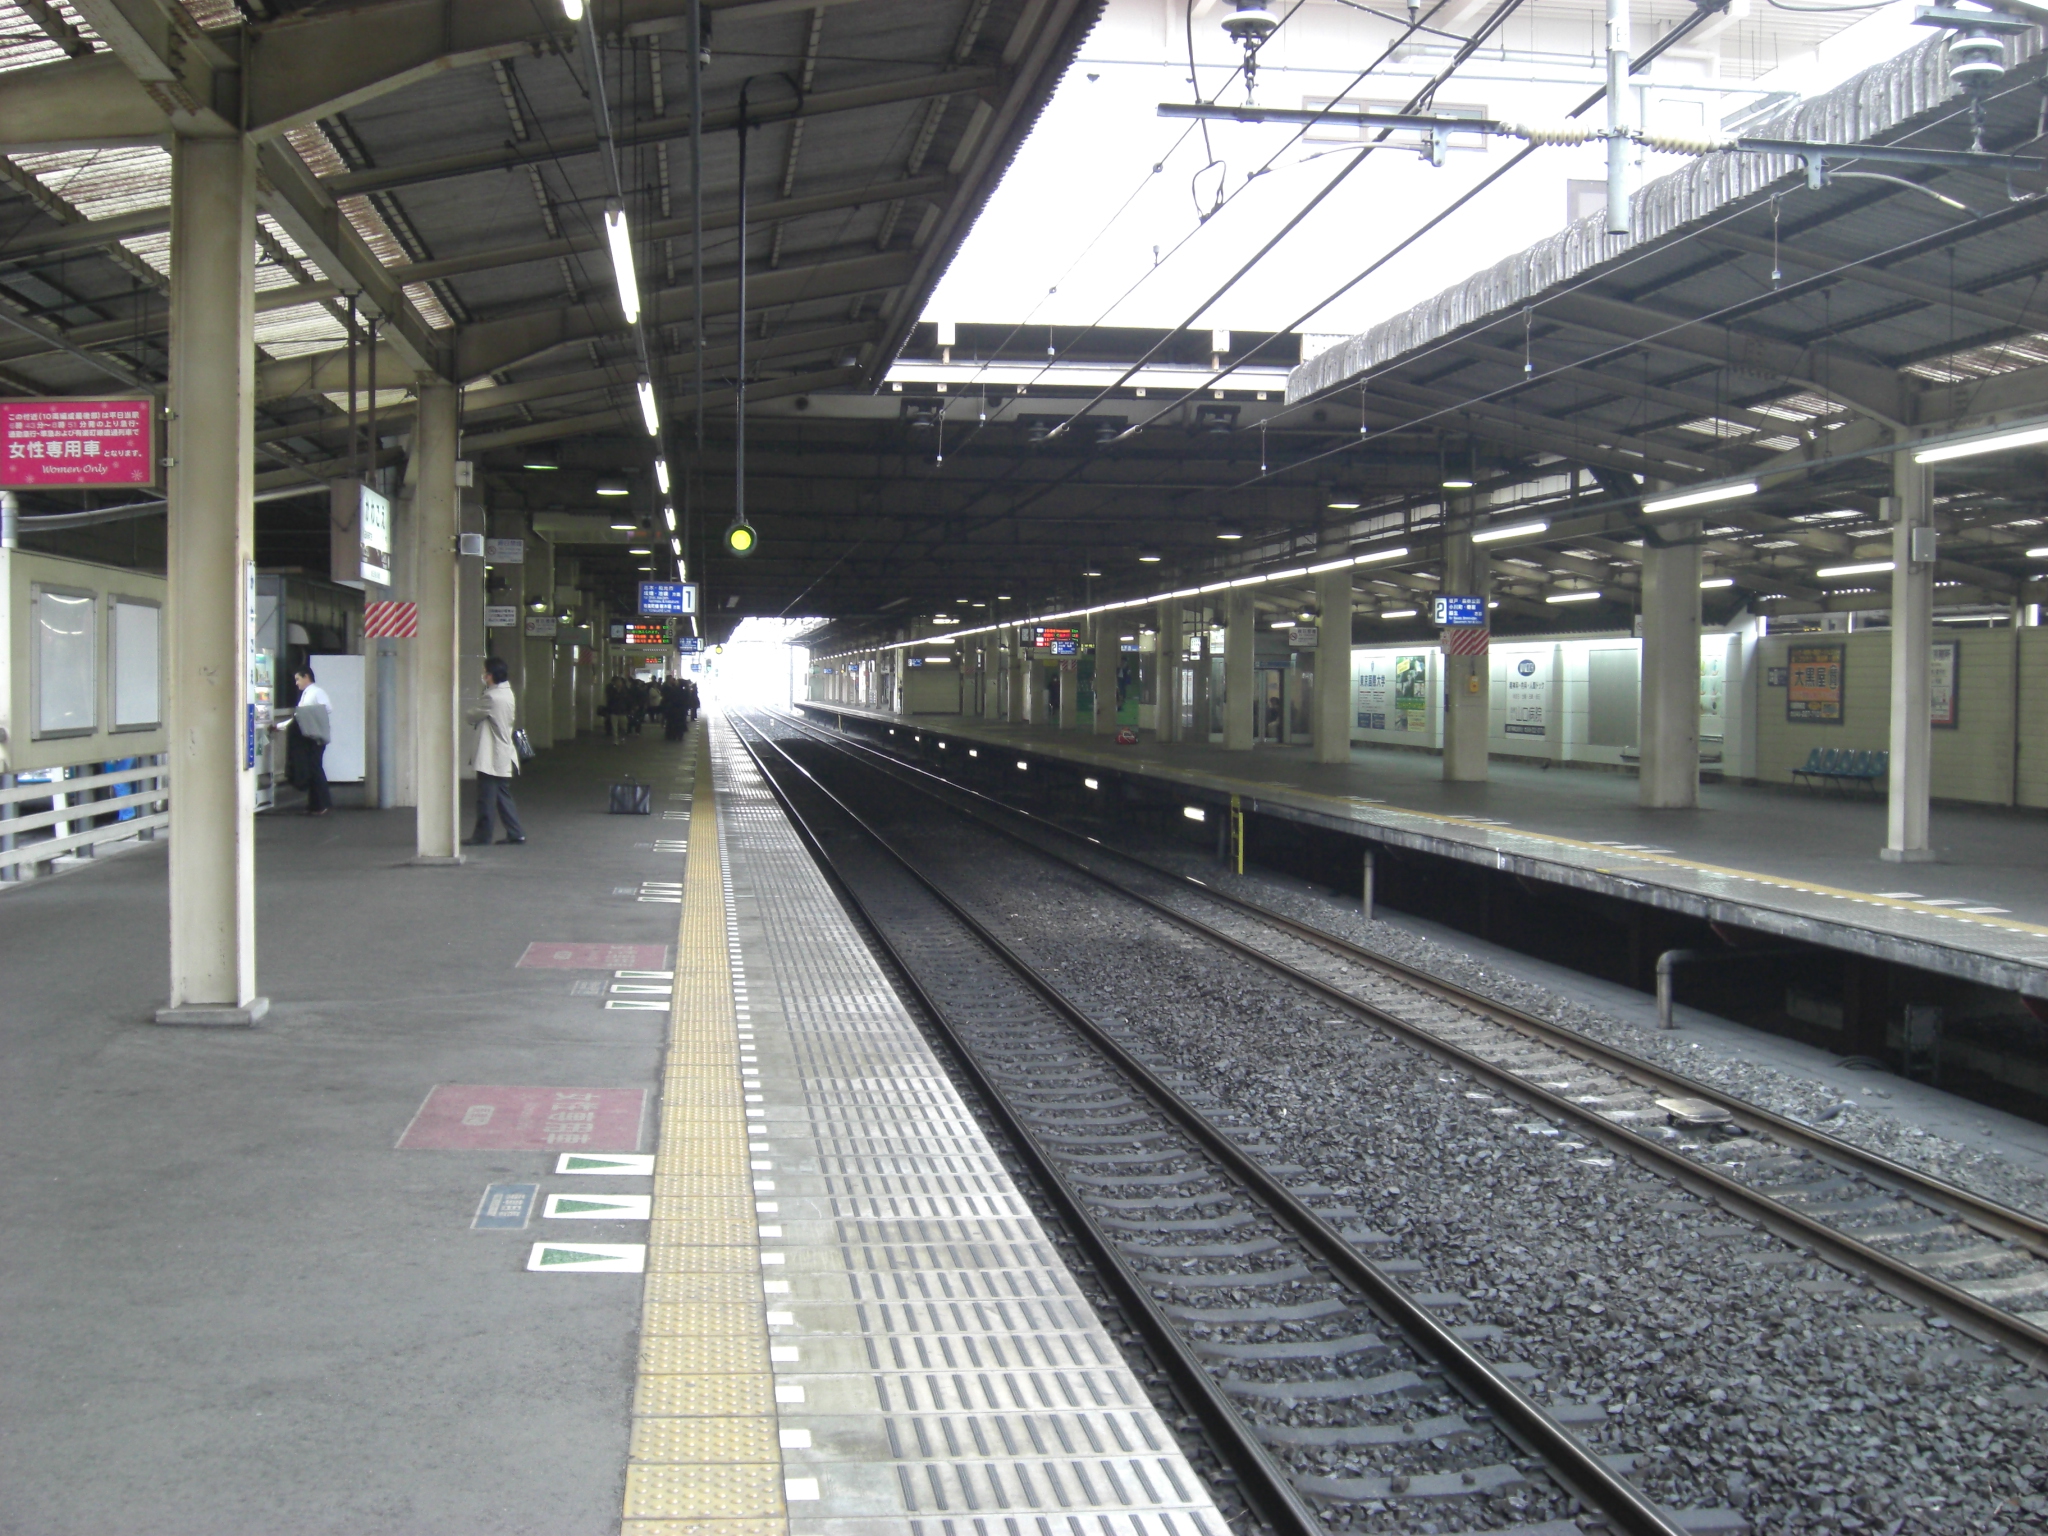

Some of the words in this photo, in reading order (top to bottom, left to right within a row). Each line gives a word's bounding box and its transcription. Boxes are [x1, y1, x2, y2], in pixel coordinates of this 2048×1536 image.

[8, 440, 101, 459] 女性専用車
[103, 450, 143, 458] となります。
[42, 465, 81, 475] Women
[83, 463, 108, 475] Only
[685, 590, 691, 609] 1
[1436, 602, 1445, 619] 2
[1051, 643, 1057, 653] 2
[1794, 666, 1827, 688] 大黒屋
